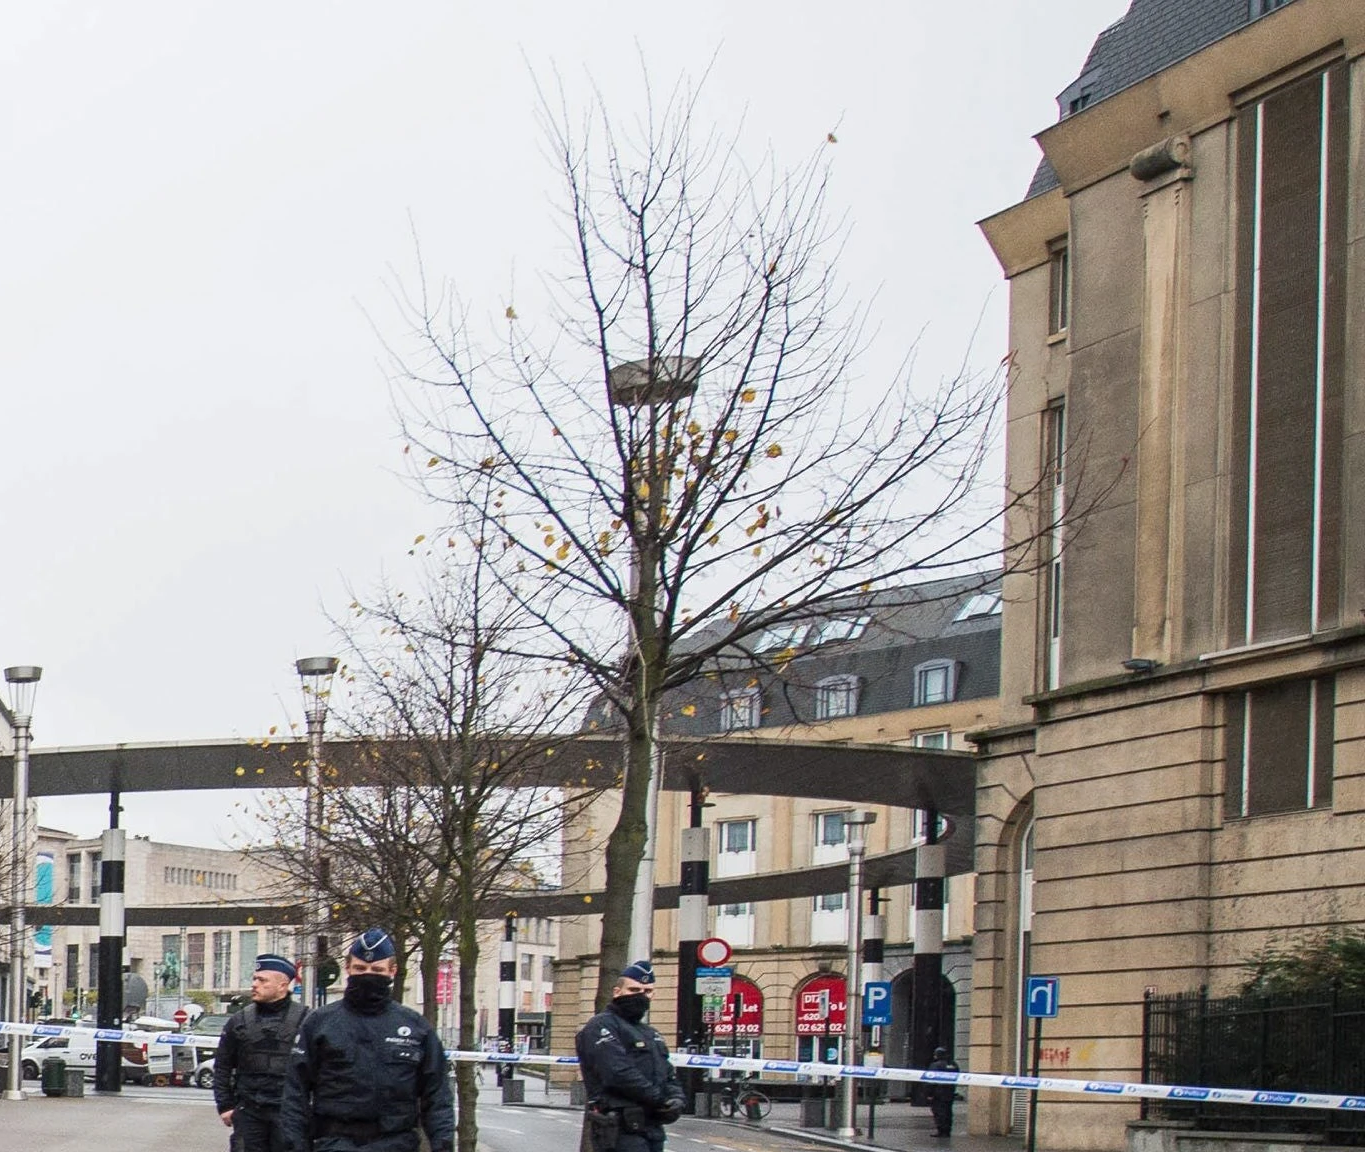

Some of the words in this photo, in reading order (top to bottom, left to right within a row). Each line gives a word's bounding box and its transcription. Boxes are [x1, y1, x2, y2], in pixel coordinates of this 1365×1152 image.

[868, 987, 887, 1010] P
[747, 1024, 759, 1033] 02
[797, 1023, 810, 1032] 02
